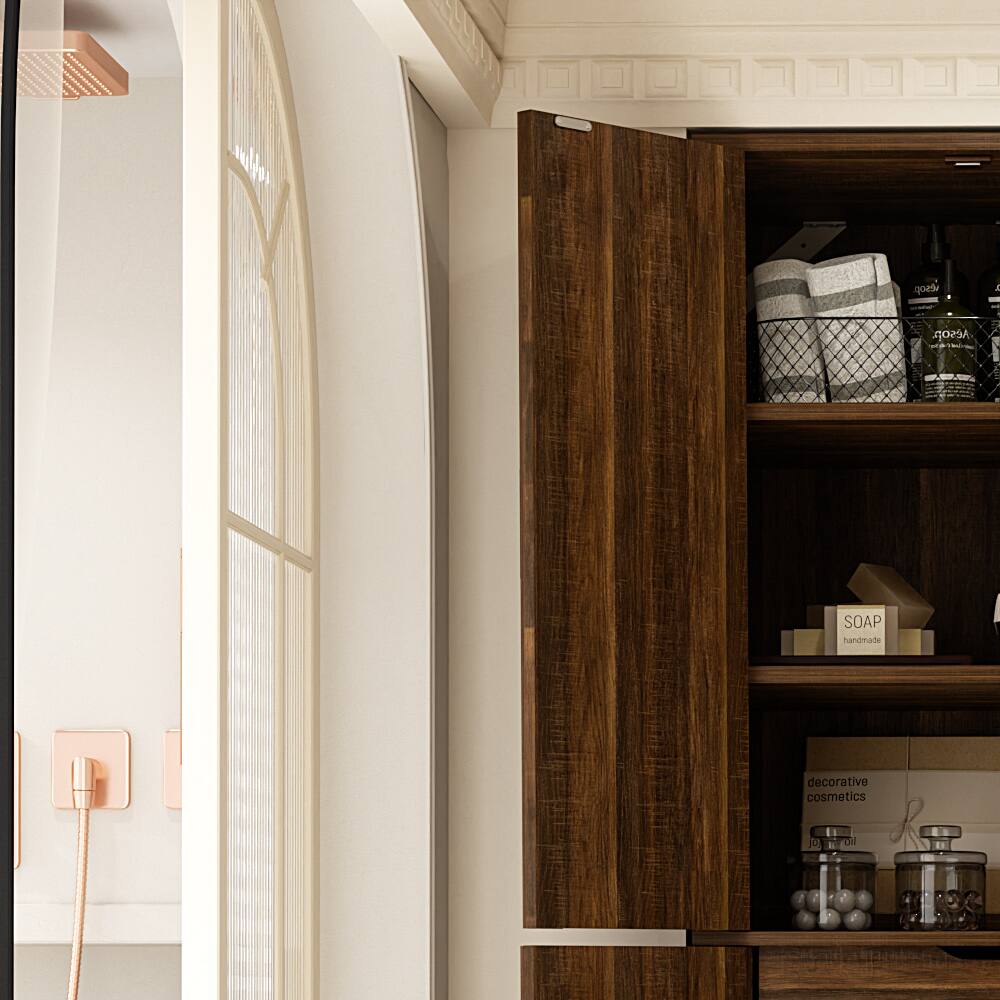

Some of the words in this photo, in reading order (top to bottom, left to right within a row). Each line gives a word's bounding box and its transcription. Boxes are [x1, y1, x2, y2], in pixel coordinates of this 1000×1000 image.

[844, 614, 882, 629] SOAP
[843, 636, 881, 644] handmade
[807, 776, 869, 788] decorative
[807, 791, 866, 802] cosmetics
[844, 836, 857, 846] oil
